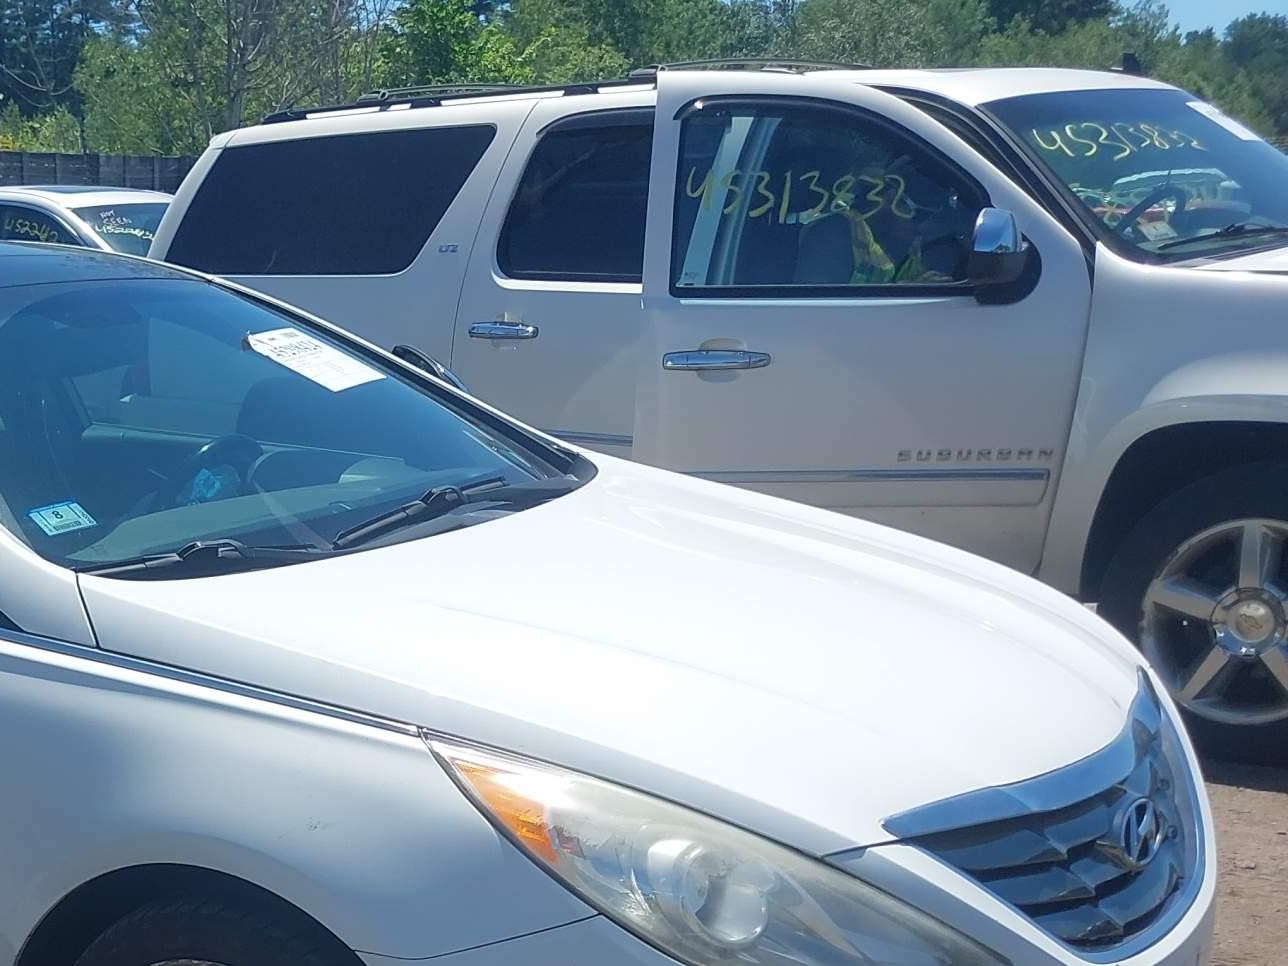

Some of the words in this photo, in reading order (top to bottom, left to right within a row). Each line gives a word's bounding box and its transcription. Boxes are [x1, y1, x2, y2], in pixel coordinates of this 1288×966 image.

[686, 166, 916, 224] 45313832
[896, 448, 1054, 462] SUBURBAN
[51, 510, 64, 520] 8
